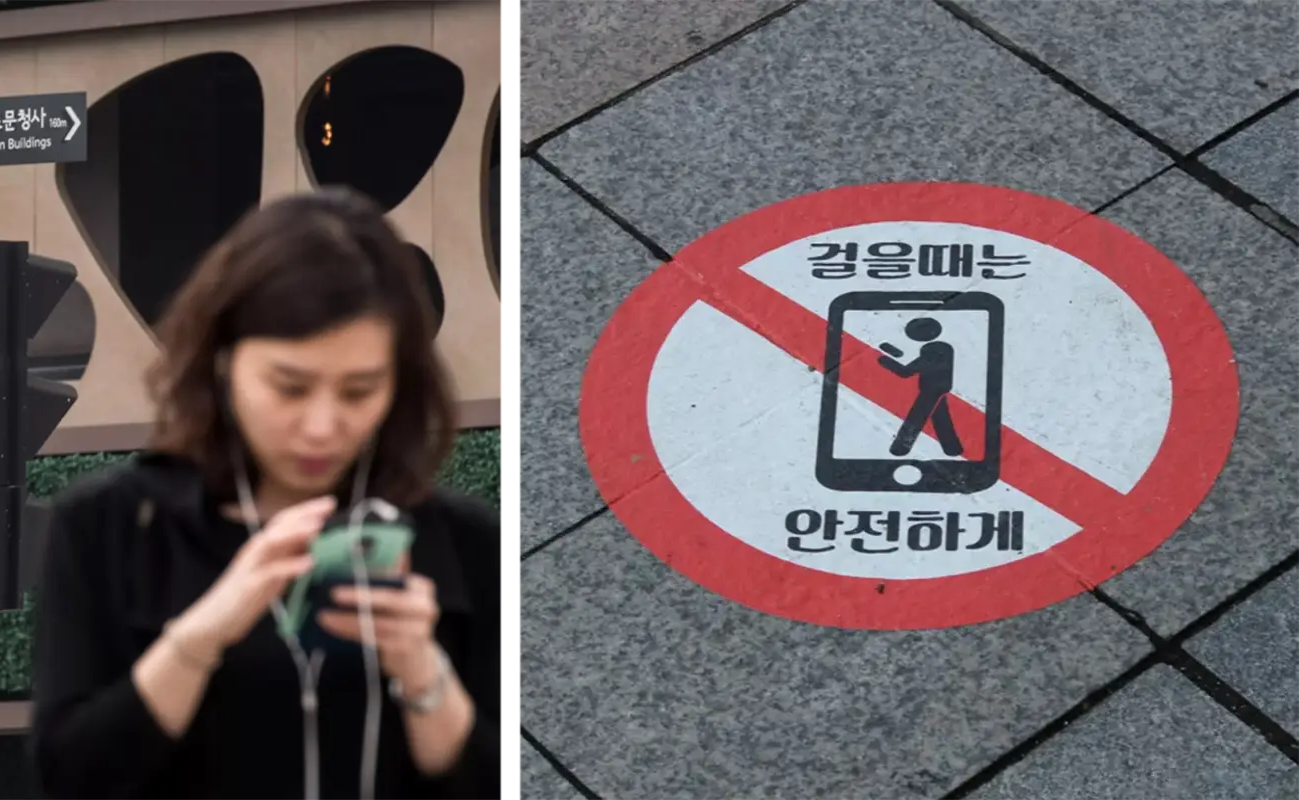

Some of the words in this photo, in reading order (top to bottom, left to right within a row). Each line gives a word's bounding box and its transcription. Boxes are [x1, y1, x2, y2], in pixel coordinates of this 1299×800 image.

[49, 117, 67, 128] 160m
[7, 136, 52, 151] Buildings
[807, 241, 1032, 281] 걸을때는
[784, 508, 1025, 555] 안전하게
